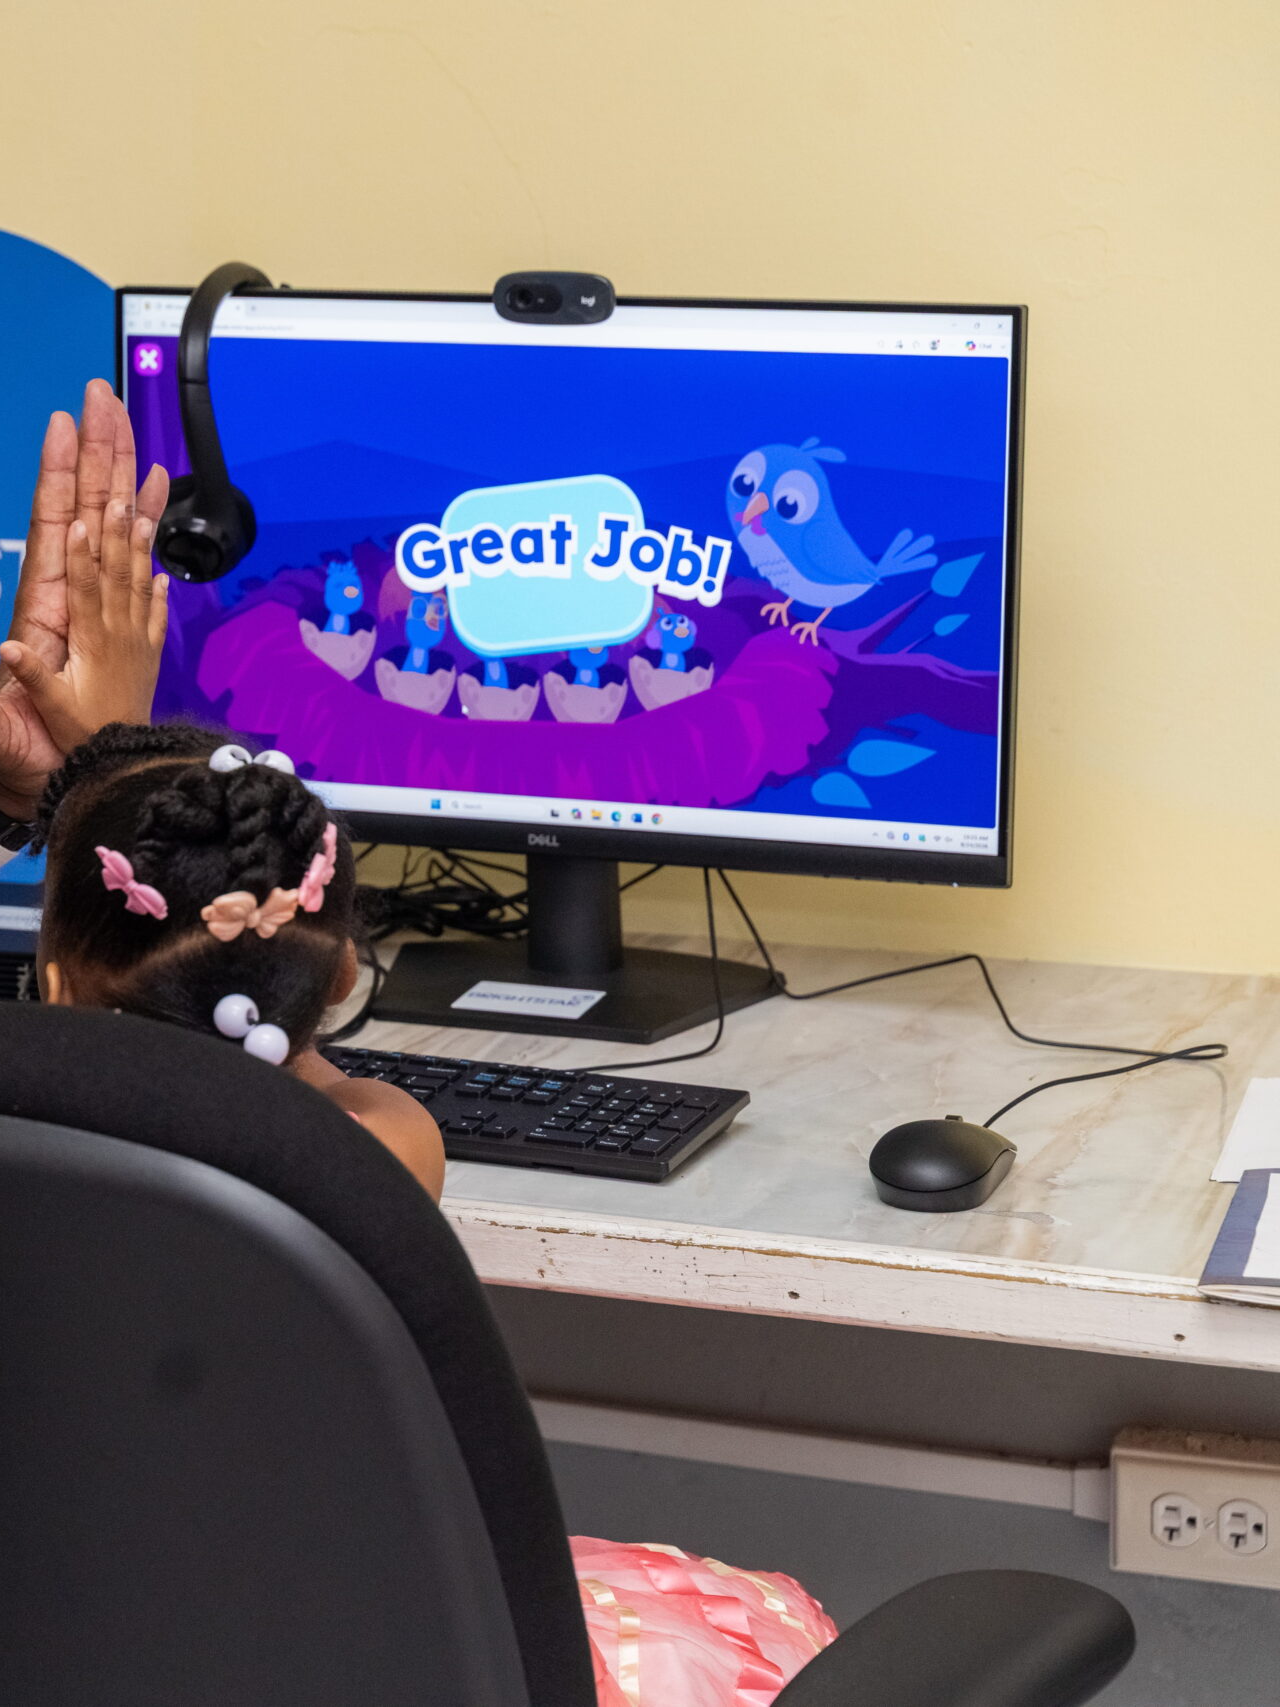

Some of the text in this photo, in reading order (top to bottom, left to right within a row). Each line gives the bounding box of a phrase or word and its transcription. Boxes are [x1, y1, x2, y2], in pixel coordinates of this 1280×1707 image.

[581, 295, 596, 307] logi
[401, 518, 726, 594] Great Job!
[527, 833, 561, 847] DELL
